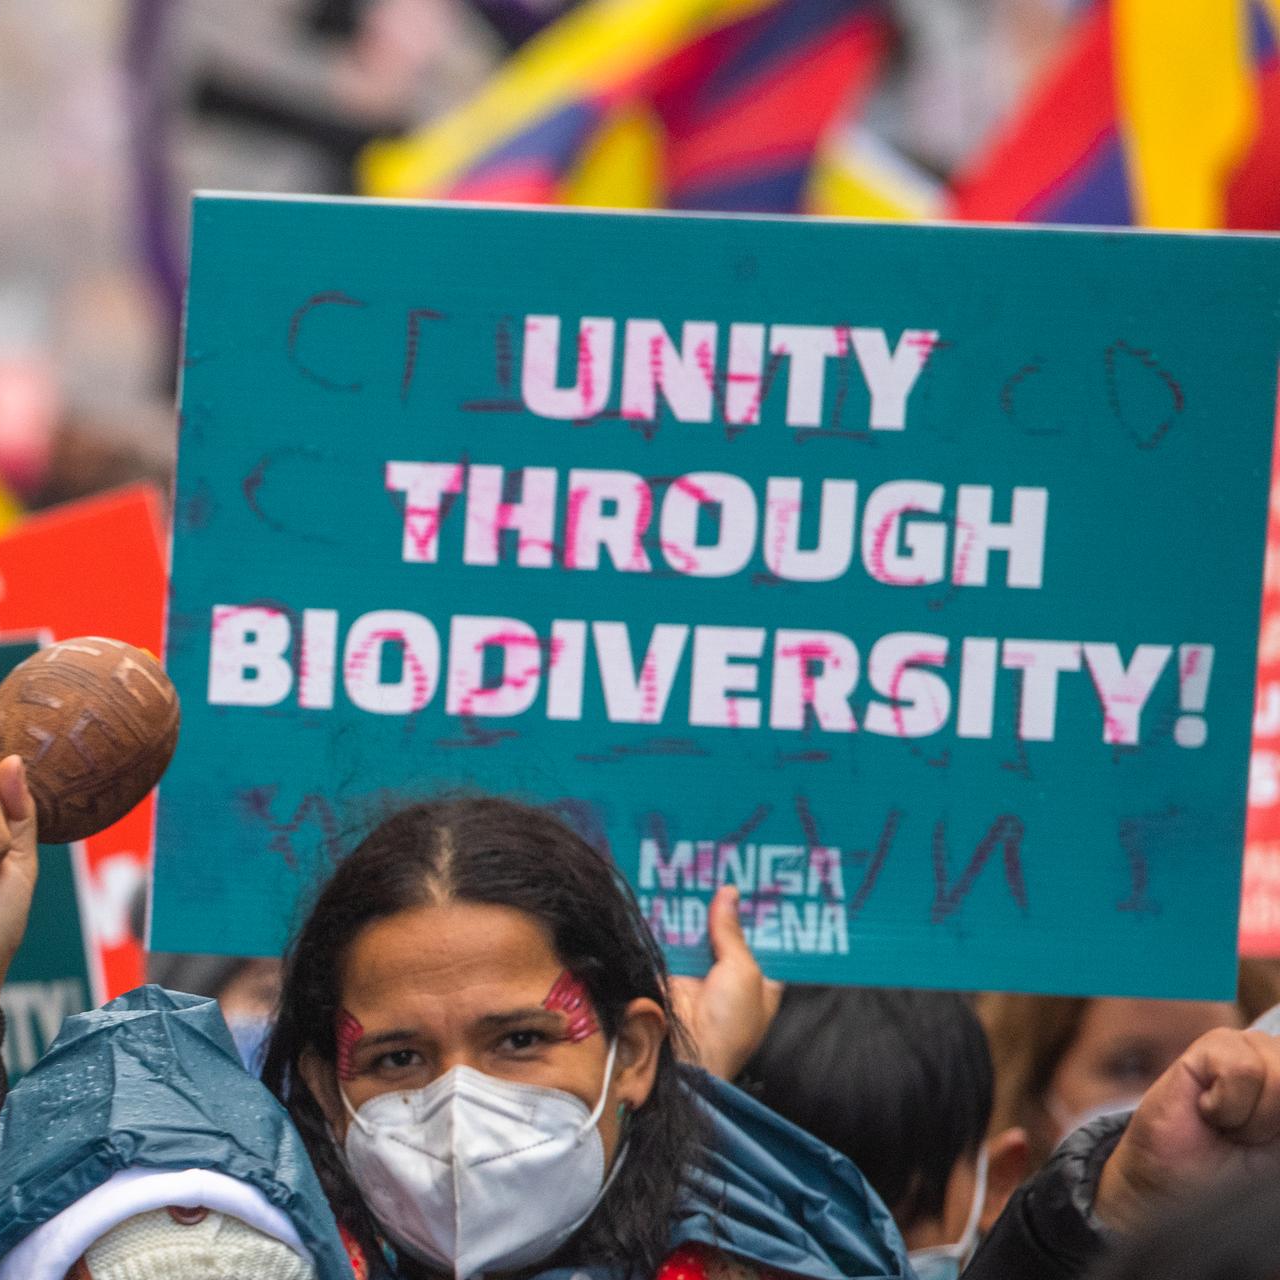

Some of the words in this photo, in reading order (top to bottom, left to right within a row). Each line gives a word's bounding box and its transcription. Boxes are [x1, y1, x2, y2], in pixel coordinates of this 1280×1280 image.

[521, 315, 939, 431] UNITY
[384, 459, 1049, 590] THROUGH
[206, 602, 1216, 750] BIODIVERSITY!
